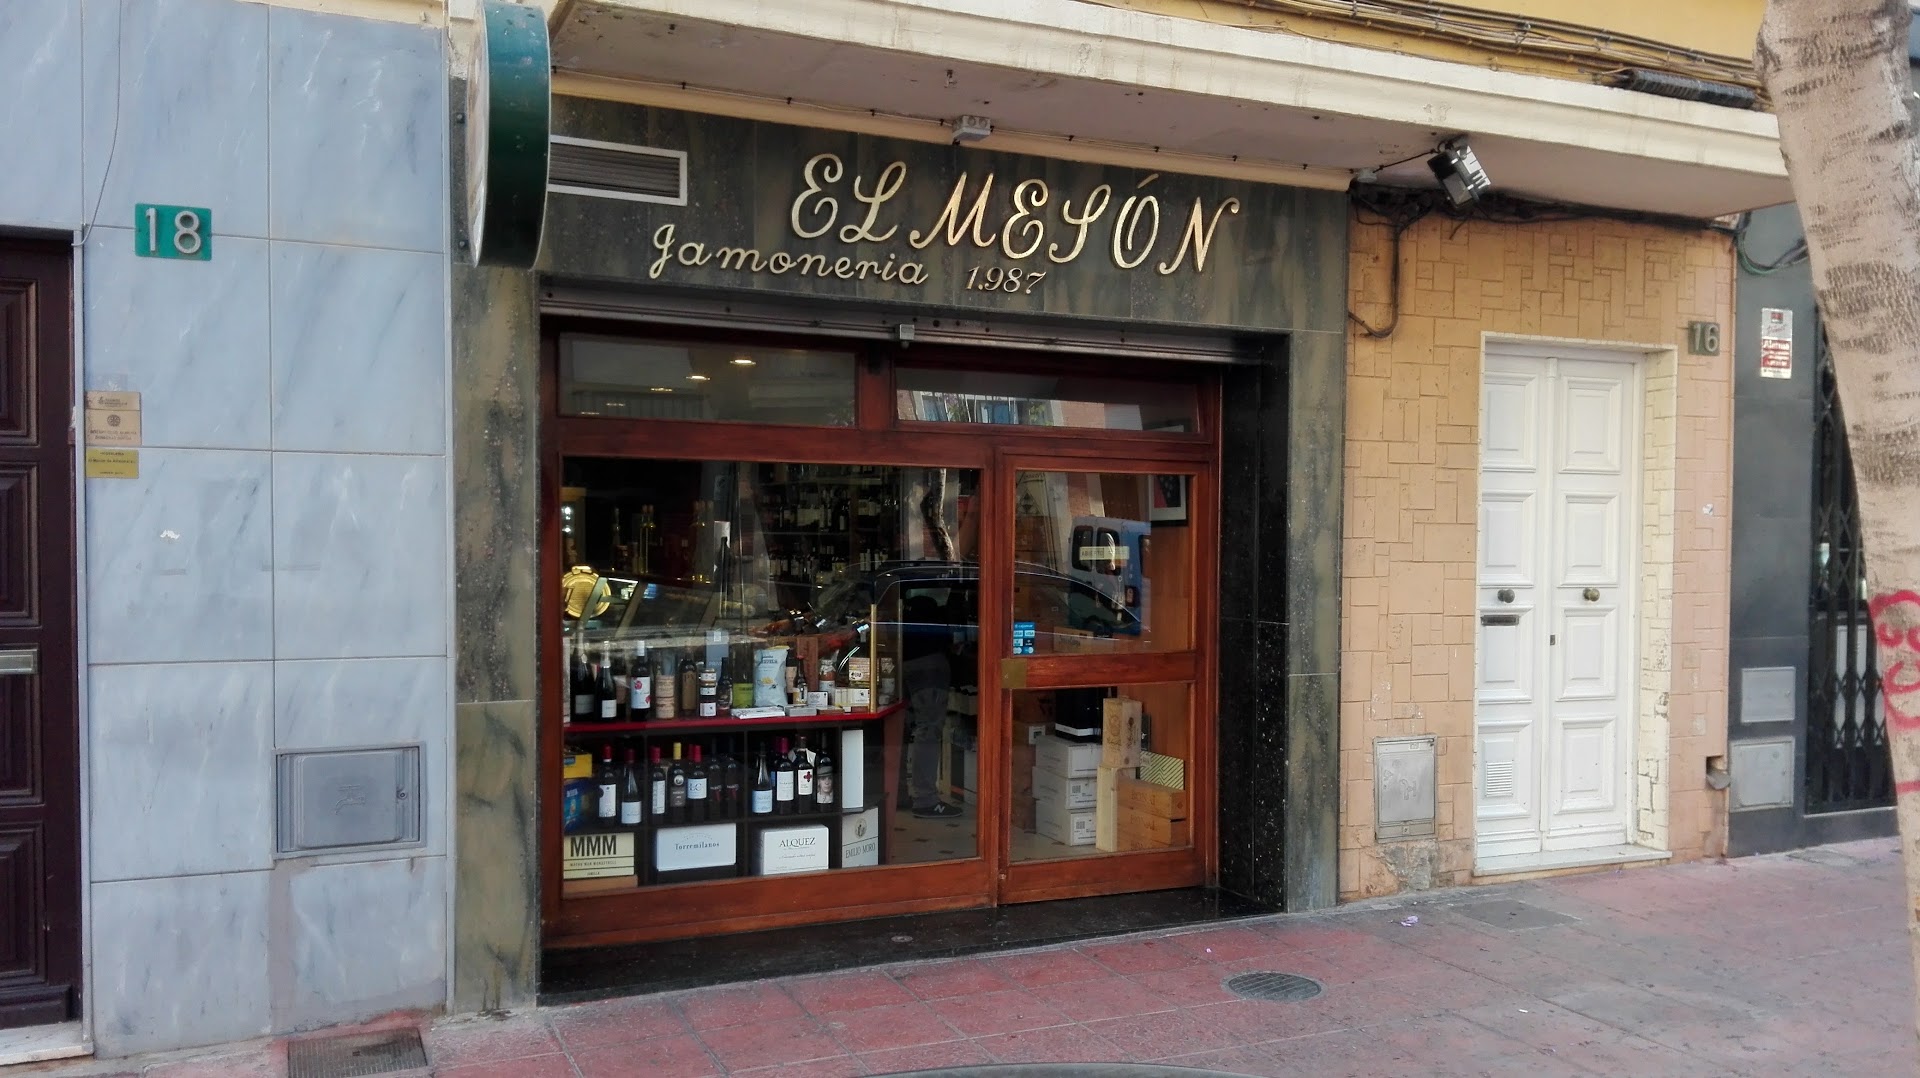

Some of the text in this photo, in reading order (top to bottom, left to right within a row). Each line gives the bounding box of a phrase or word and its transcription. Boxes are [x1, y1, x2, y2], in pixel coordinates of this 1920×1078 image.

[791, 153, 1240, 275] EL MESÓN
[145, 207, 201, 255] 18
[649, 224, 929, 285] Jamoneria
[964, 265, 1047, 295] 1.987
[1693, 323, 1719, 352] 16
[570, 834, 617, 858] MMM
[675, 841, 720, 851] Torremilanos
[779, 837, 816, 848] ALQUEZ
[845, 842, 876, 859] EMILIO MORO
